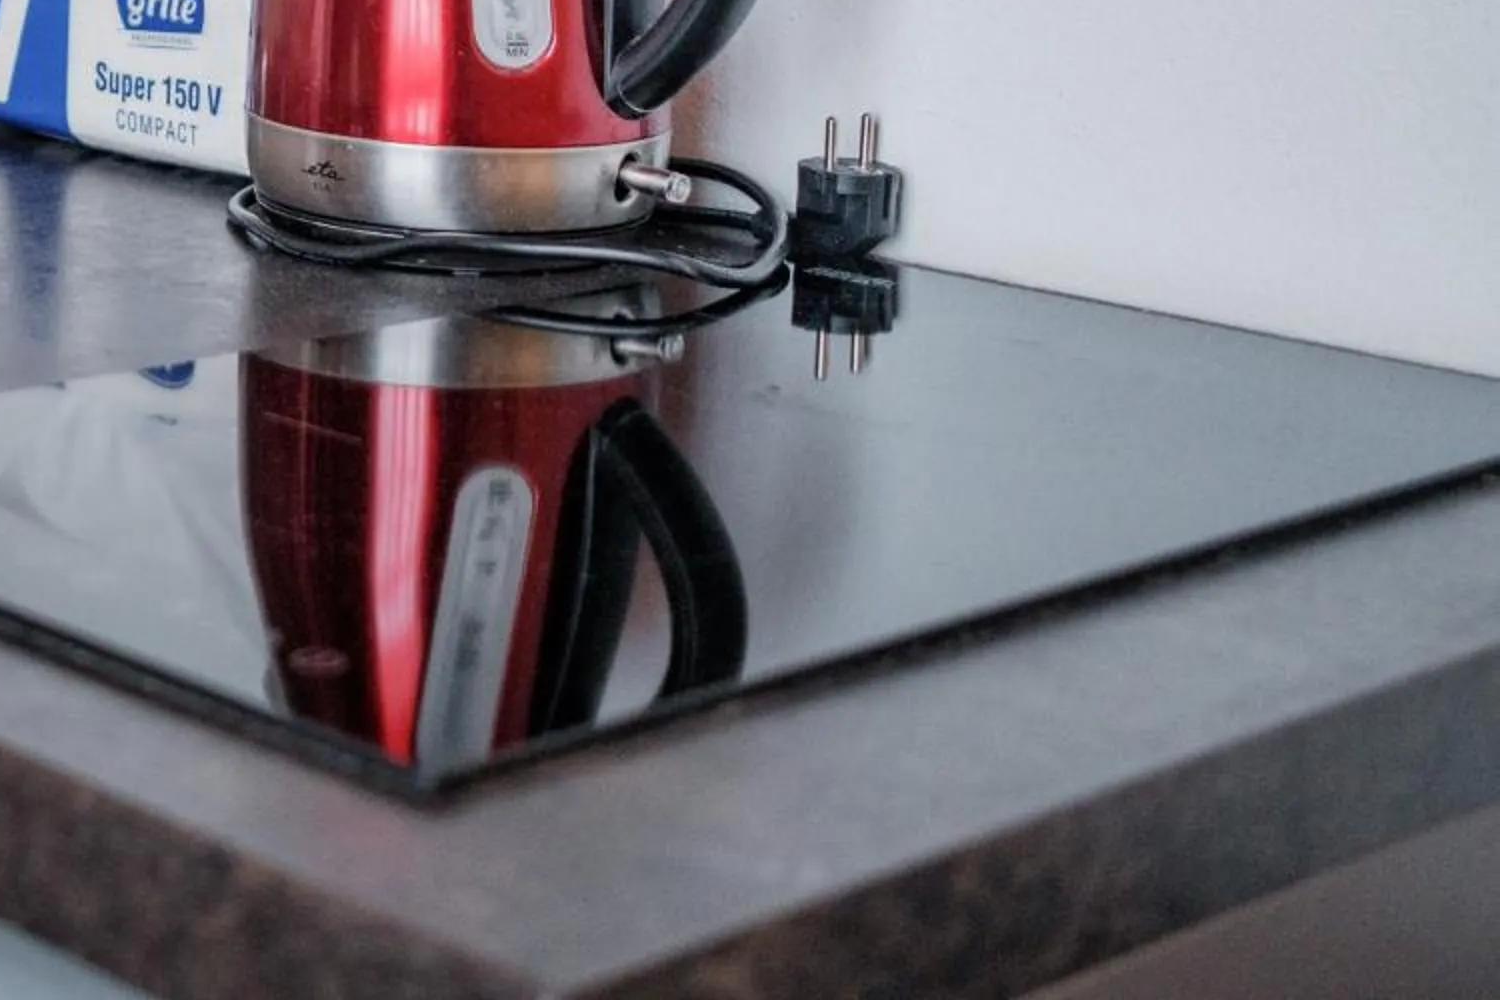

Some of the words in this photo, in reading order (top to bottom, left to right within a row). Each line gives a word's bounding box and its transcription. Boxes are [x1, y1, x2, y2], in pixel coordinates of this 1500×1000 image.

[95, 61, 156, 102] Super
[163, 75, 200, 111] 150
[207, 83, 223, 116] V
[115, 107, 197, 146] COMPACT
